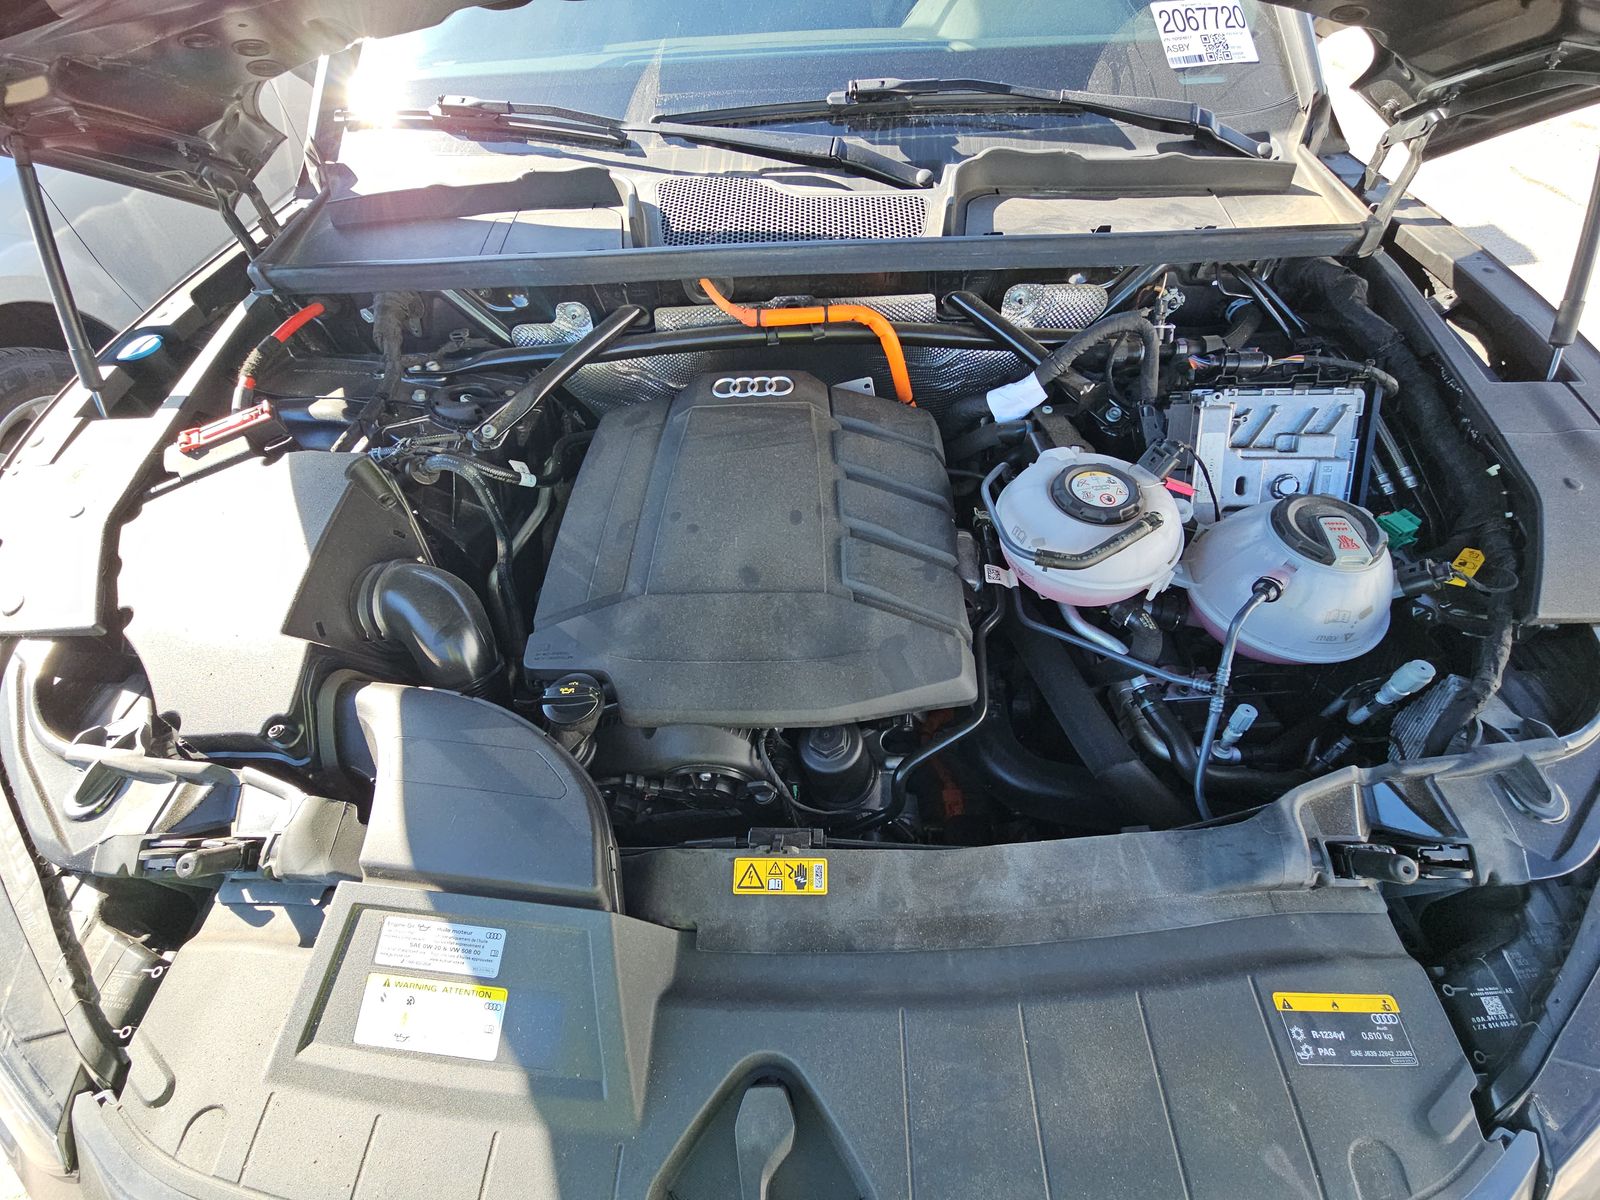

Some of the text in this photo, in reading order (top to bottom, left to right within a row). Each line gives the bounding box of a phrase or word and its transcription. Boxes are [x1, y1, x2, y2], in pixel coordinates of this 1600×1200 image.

[1158, 5, 1246, 34] 2067720
[1166, 43, 1191, 54] ASBY
[394, 980, 493, 999] WARNING ATTENTION
[1311, 1030, 1346, 1041] R-1234yf
[1382, 1032, 1395, 1042] kg
[1317, 1047, 1337, 1057] PAG
[1350, 1049, 1363, 1057] SAE
